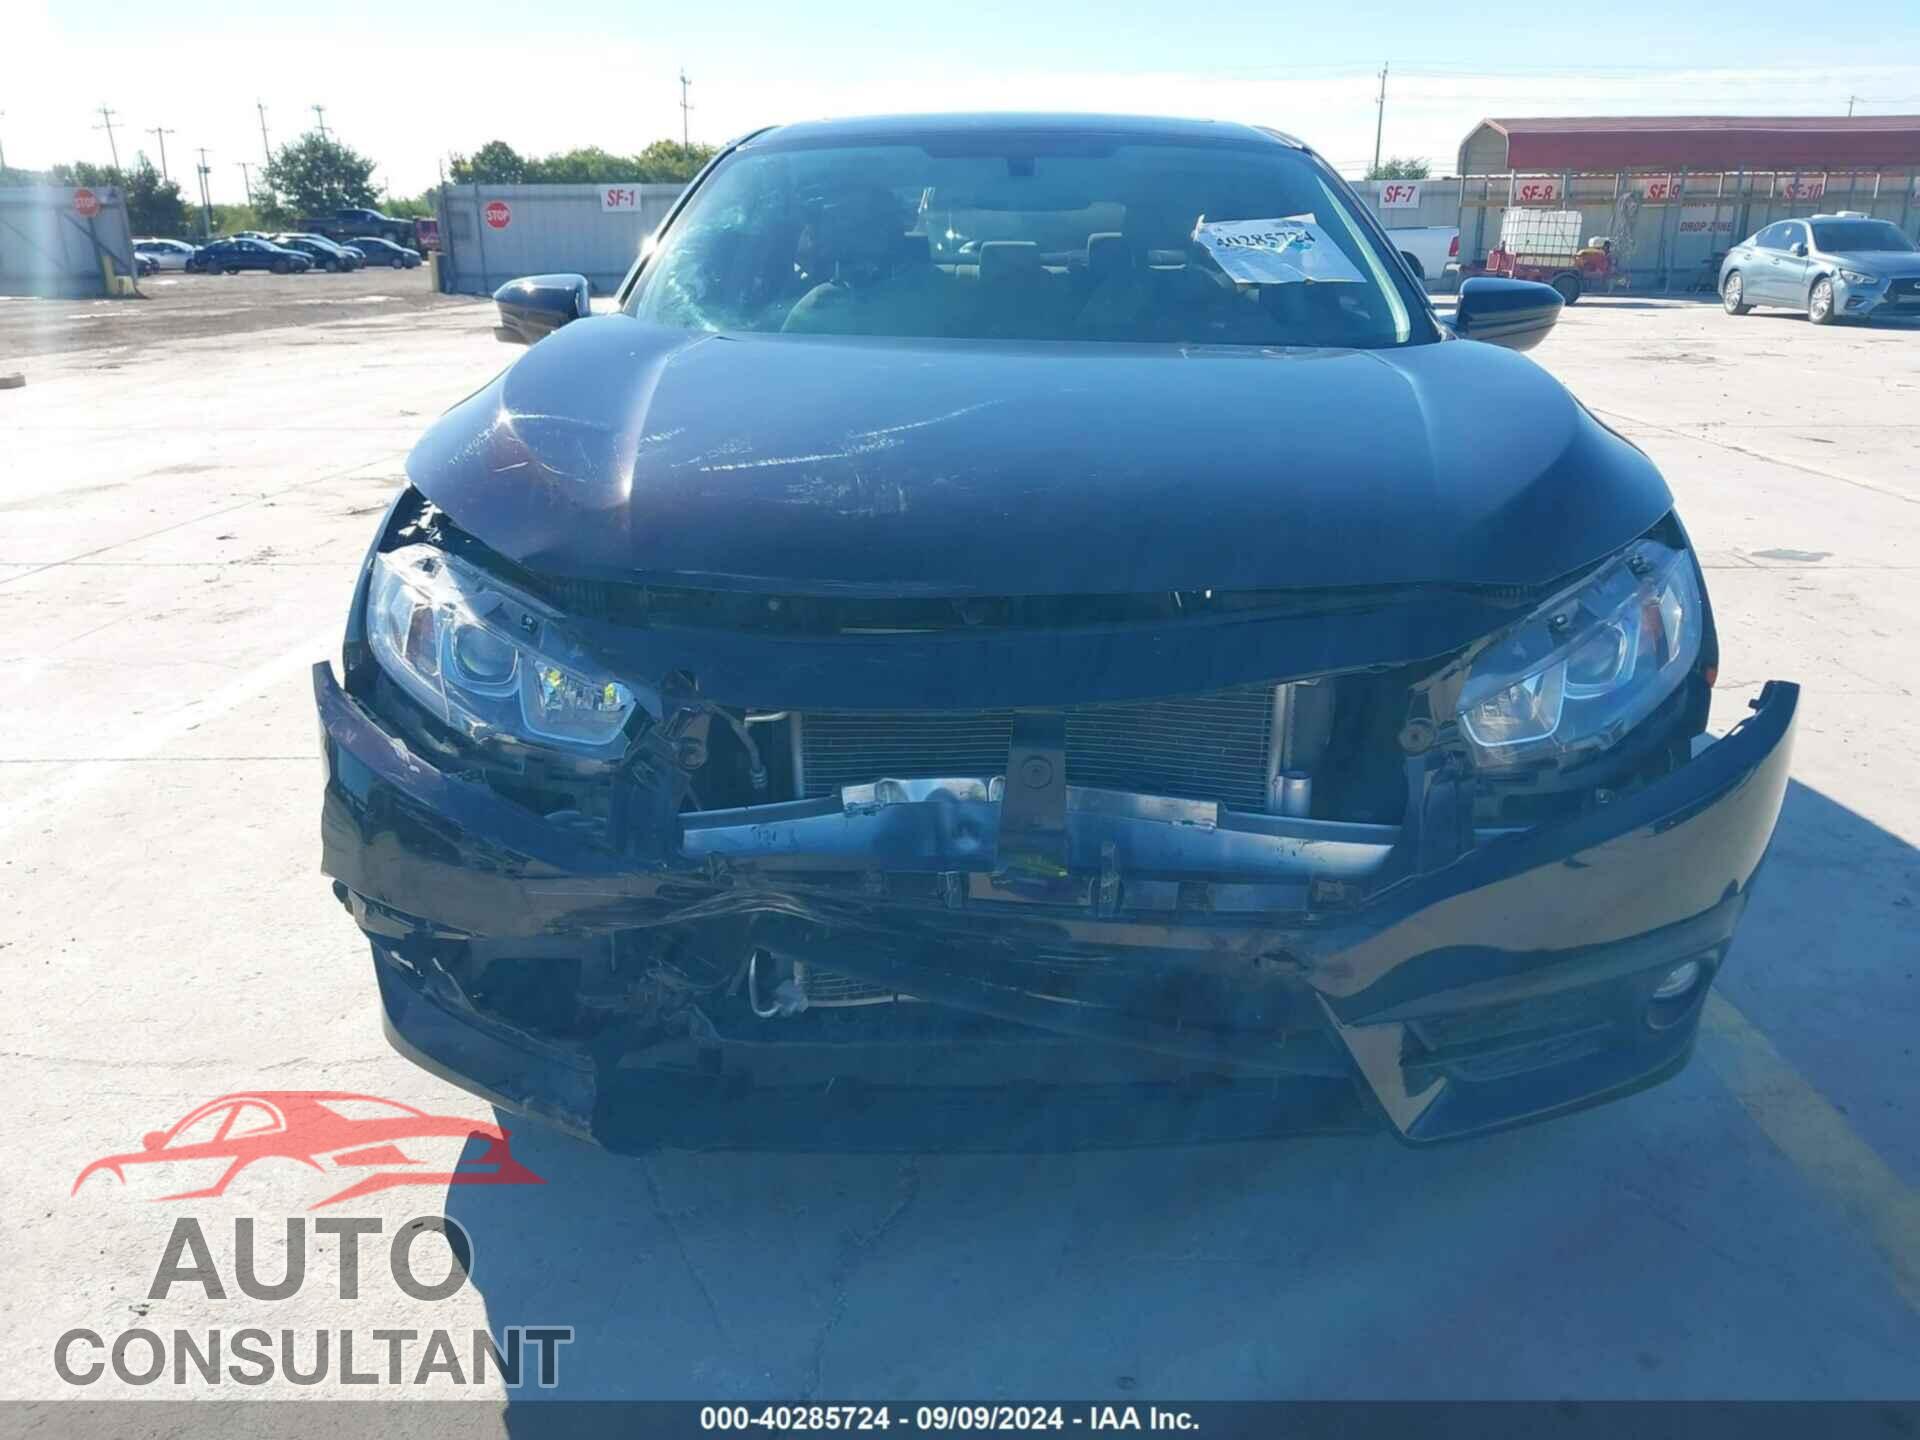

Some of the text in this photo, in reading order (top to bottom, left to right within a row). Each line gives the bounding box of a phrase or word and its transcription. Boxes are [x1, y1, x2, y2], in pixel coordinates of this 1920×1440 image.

[607, 189, 635, 207] SF-1
[1384, 185, 1416, 203] SF-7
[1521, 185, 1553, 201] SF-8
[1648, 185, 1681, 200] SF9
[487, 210, 509, 221] STOP
[1680, 221, 1706, 232] DROP
